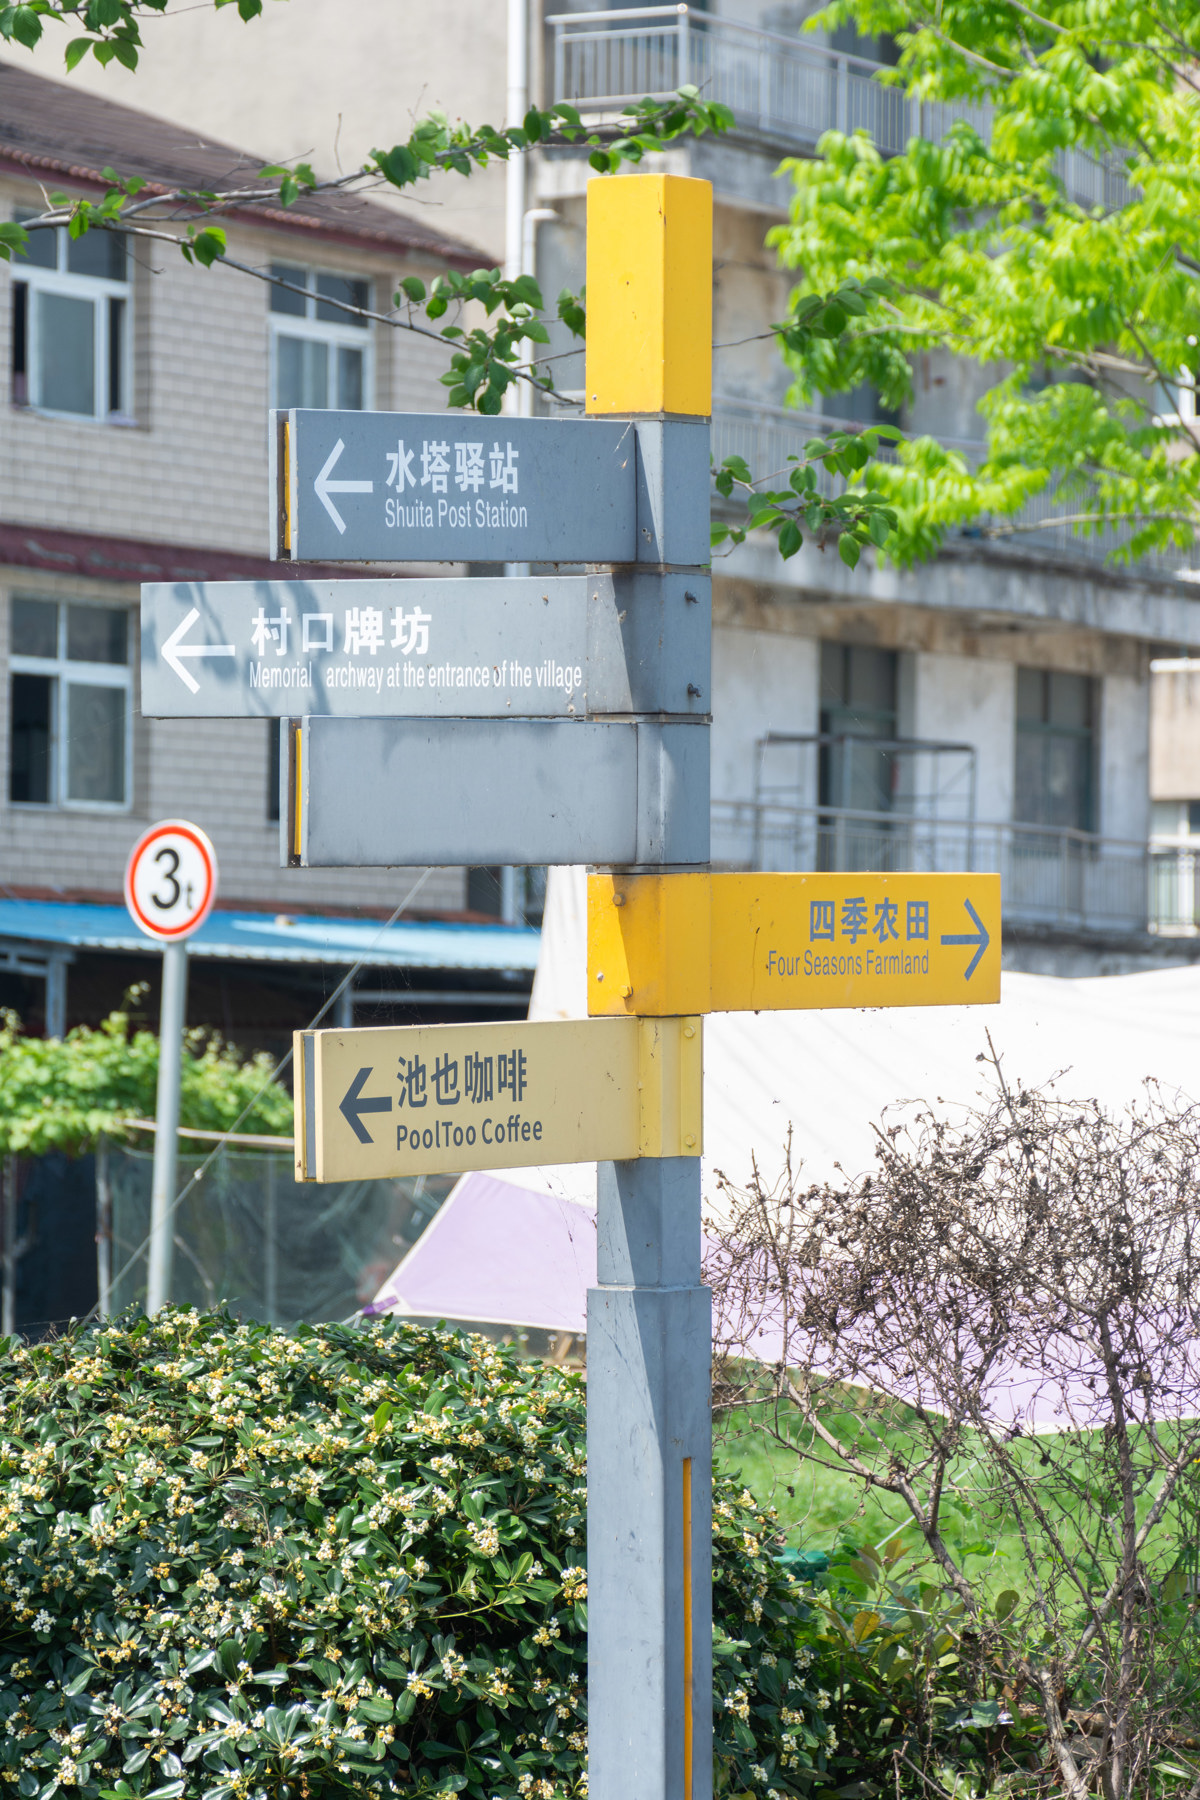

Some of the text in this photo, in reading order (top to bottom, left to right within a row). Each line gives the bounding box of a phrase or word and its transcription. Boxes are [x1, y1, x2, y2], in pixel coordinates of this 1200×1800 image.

[385, 440, 520, 494] 水塔驿站
[385, 499, 529, 528] Shuita Post Station
[251, 606, 433, 656] 村口牌坊
[249, 660, 583, 694] Memorial archway at the entrance of the village
[809, 897, 930, 945] 四季农田
[768, 949, 930, 976] Four Seasons Farmland
[396, 1049, 528, 1109] 池也咖啡
[396, 1114, 543, 1151] PoolToo Coffee
